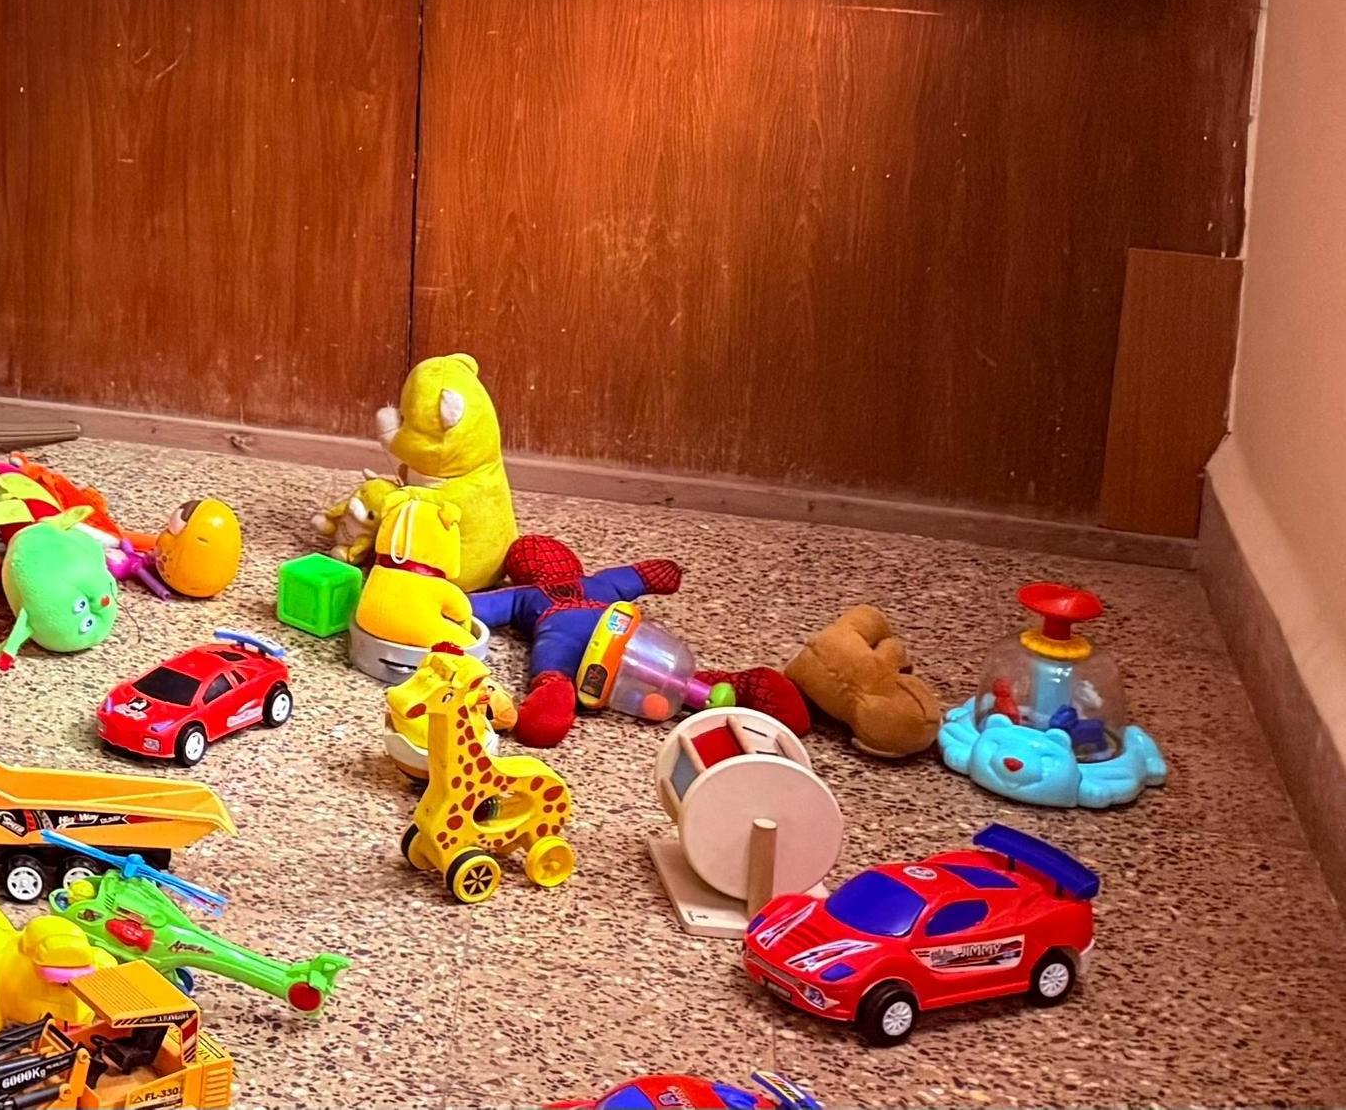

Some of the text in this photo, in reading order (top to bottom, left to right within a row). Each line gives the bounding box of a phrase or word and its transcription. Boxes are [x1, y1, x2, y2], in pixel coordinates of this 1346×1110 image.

[961, 942, 1002, 958] JIMMY
[1, 1066, 47, 1089] 6000Kg
[144, 1087, 180, 1104] FL-330
